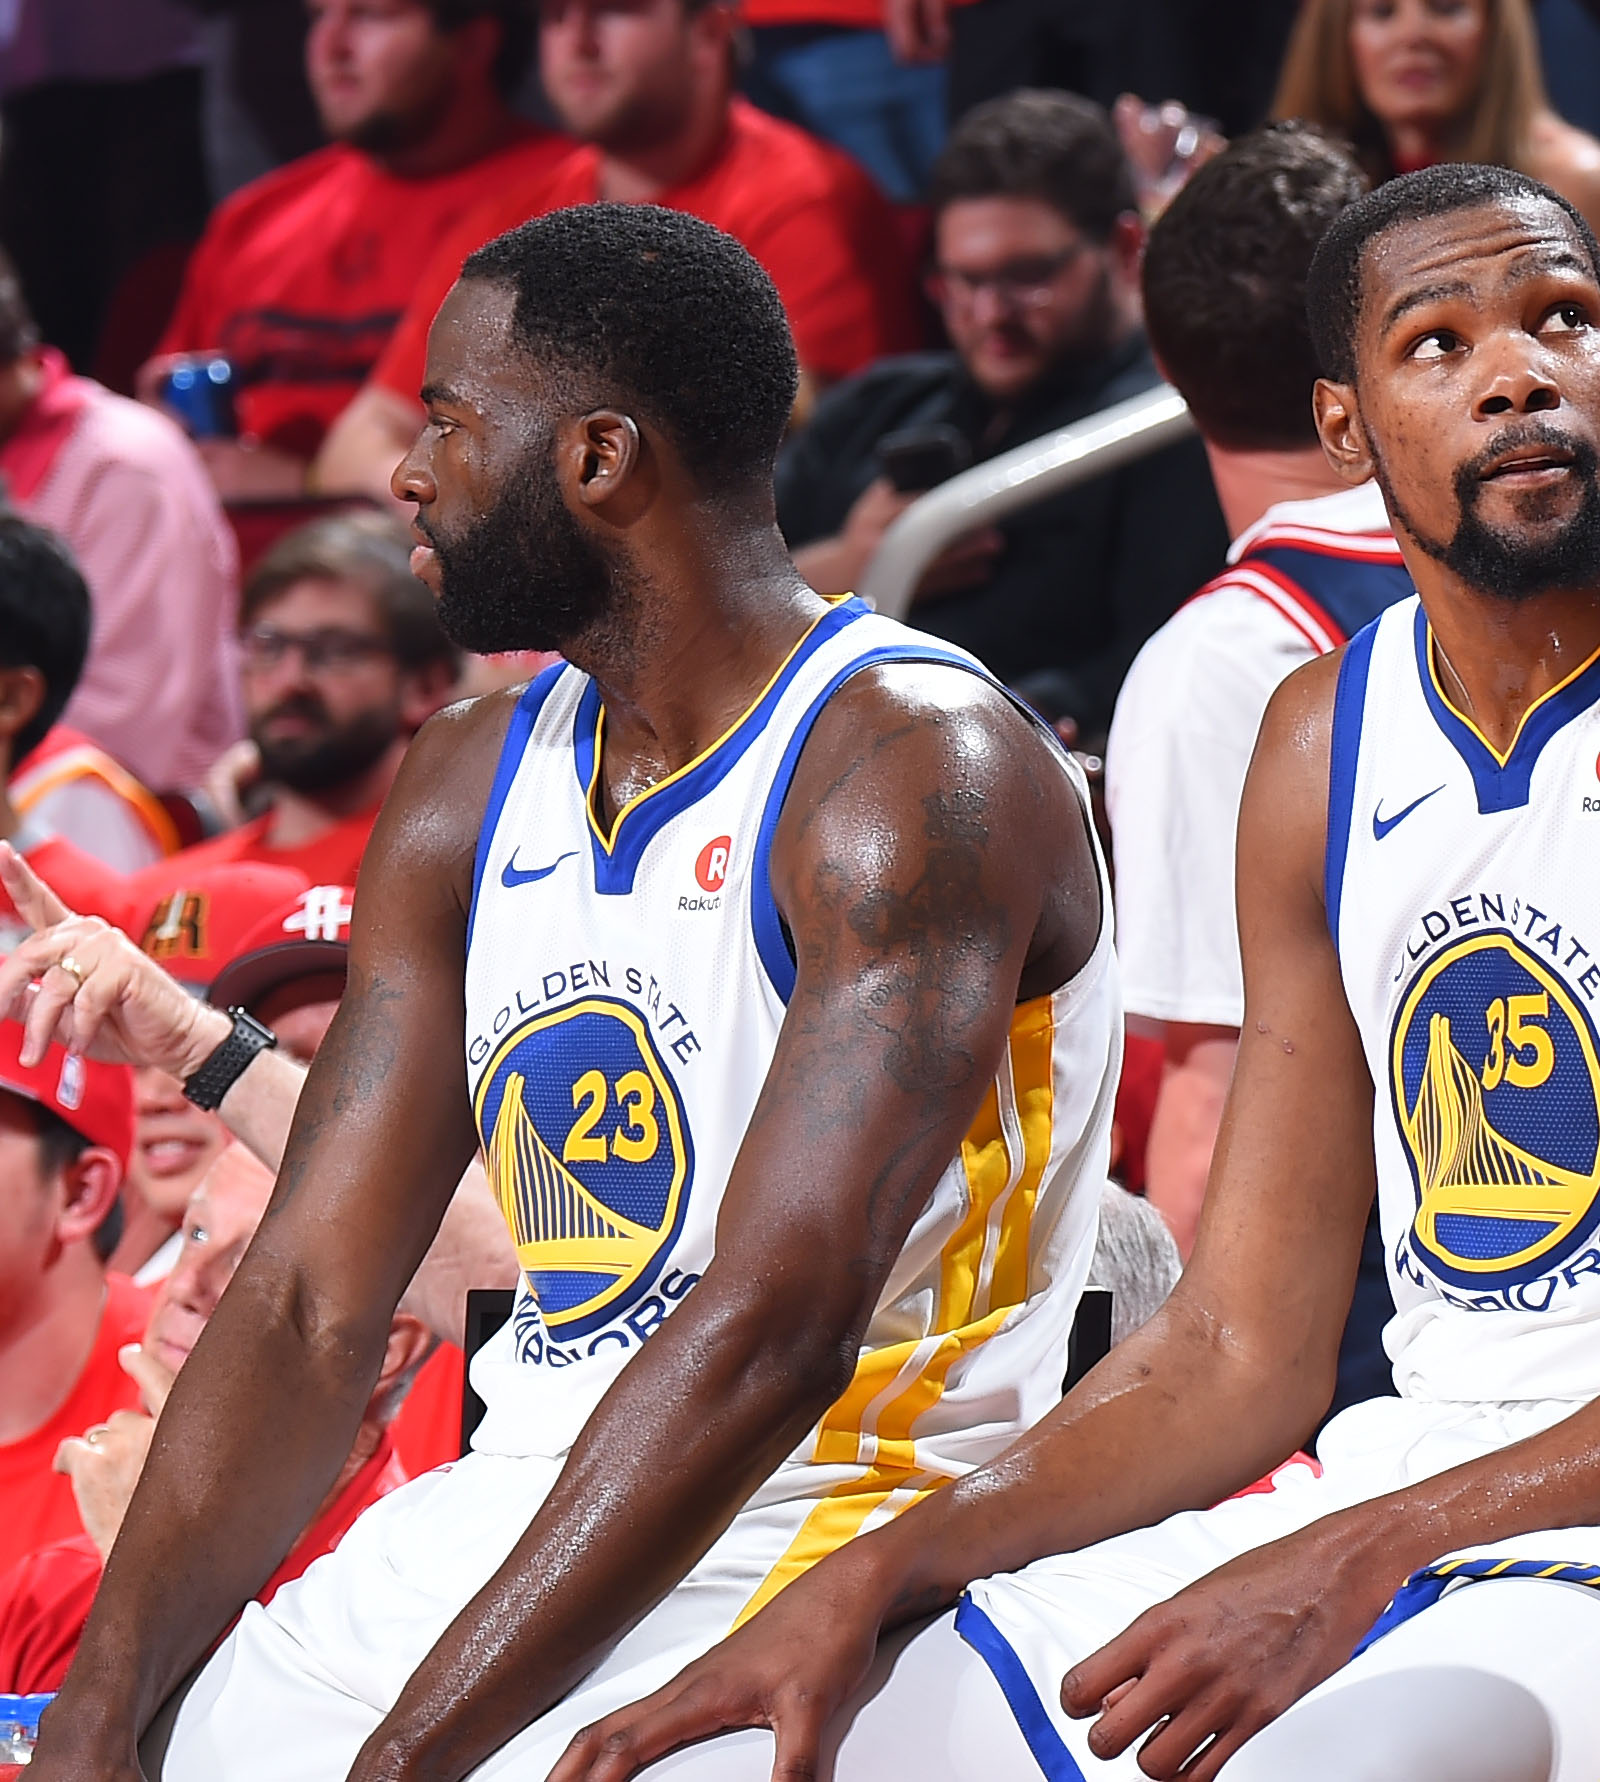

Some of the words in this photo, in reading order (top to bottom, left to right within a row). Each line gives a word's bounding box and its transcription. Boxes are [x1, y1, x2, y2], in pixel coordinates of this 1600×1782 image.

[678, 896, 721, 911] Rakut
[469, 960, 611, 1066] GOLDEN
[626, 967, 702, 1066] STATE
[1481, 990, 1556, 1091] 35
[563, 1070, 659, 1163] 23
